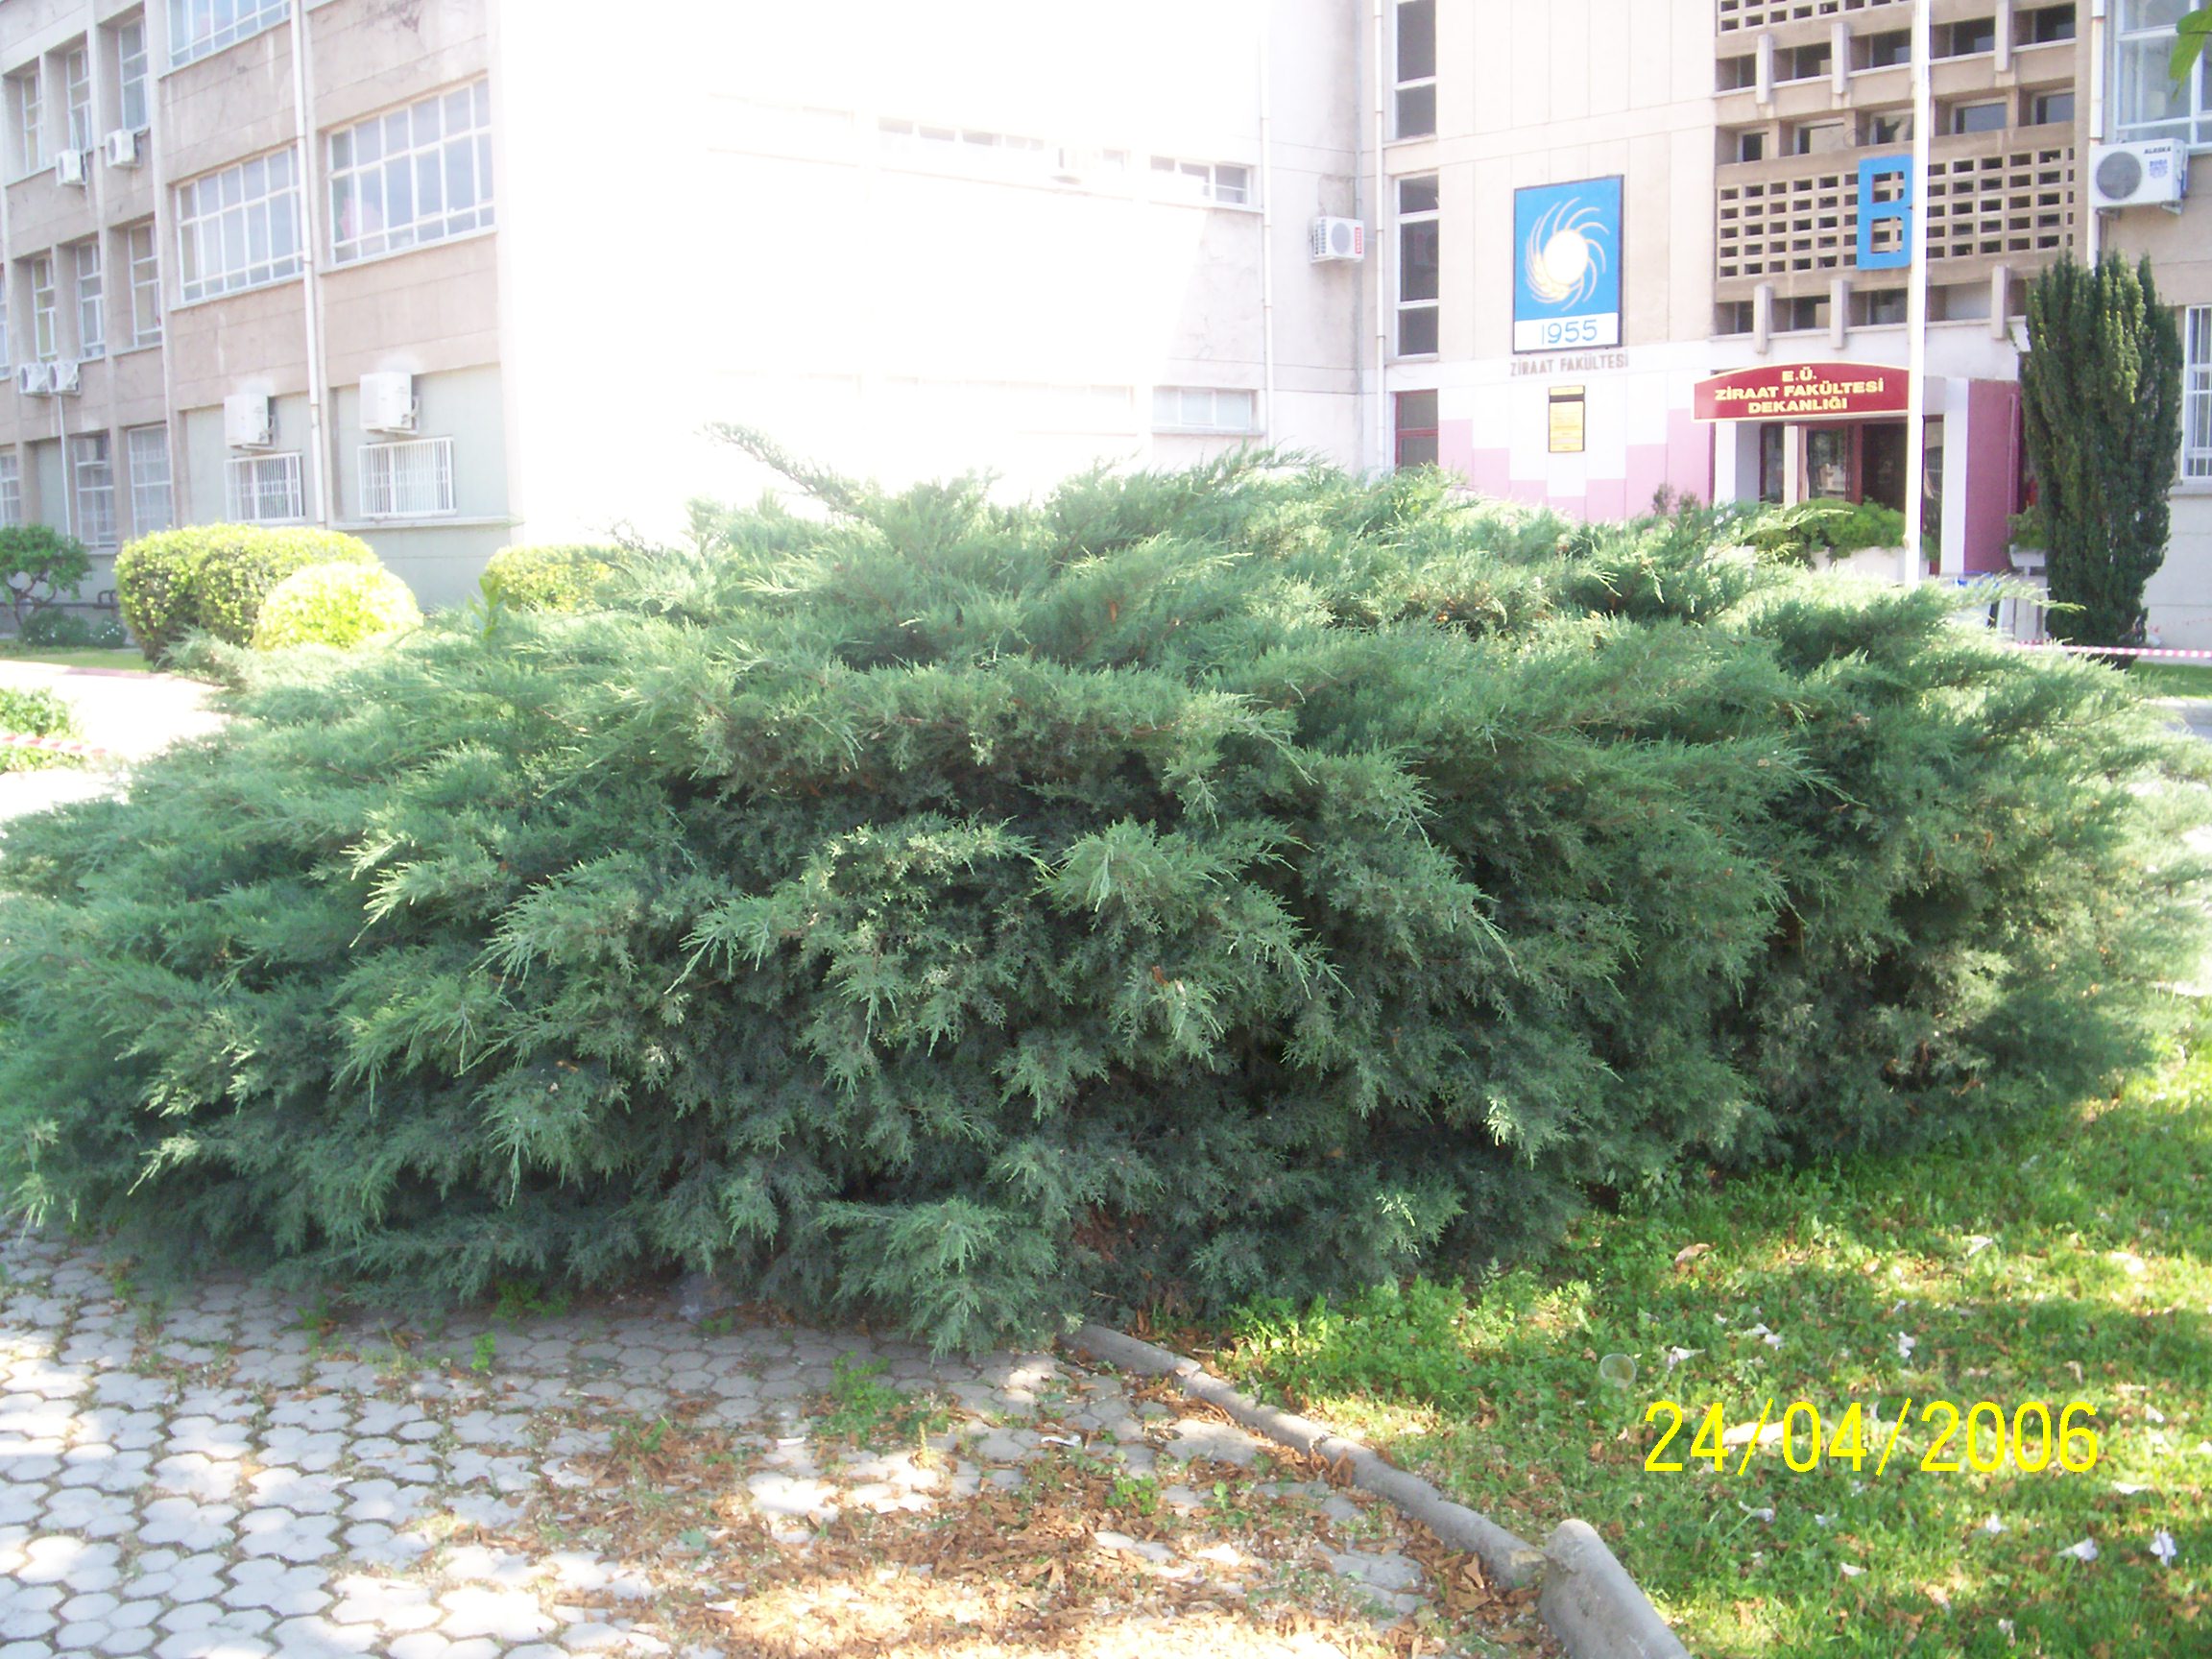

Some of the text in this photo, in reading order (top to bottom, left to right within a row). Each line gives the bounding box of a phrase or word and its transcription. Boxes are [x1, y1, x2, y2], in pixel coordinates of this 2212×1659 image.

[1857, 154, 1913, 271] B
[1542, 320, 1598, 345] 1955
[1782, 367, 1817, 382] E.Ü.
[1715, 377, 1884, 401] ZİRAAT FAKÜLTESİ
[1748, 397, 1848, 415] DEKANLIĞI
